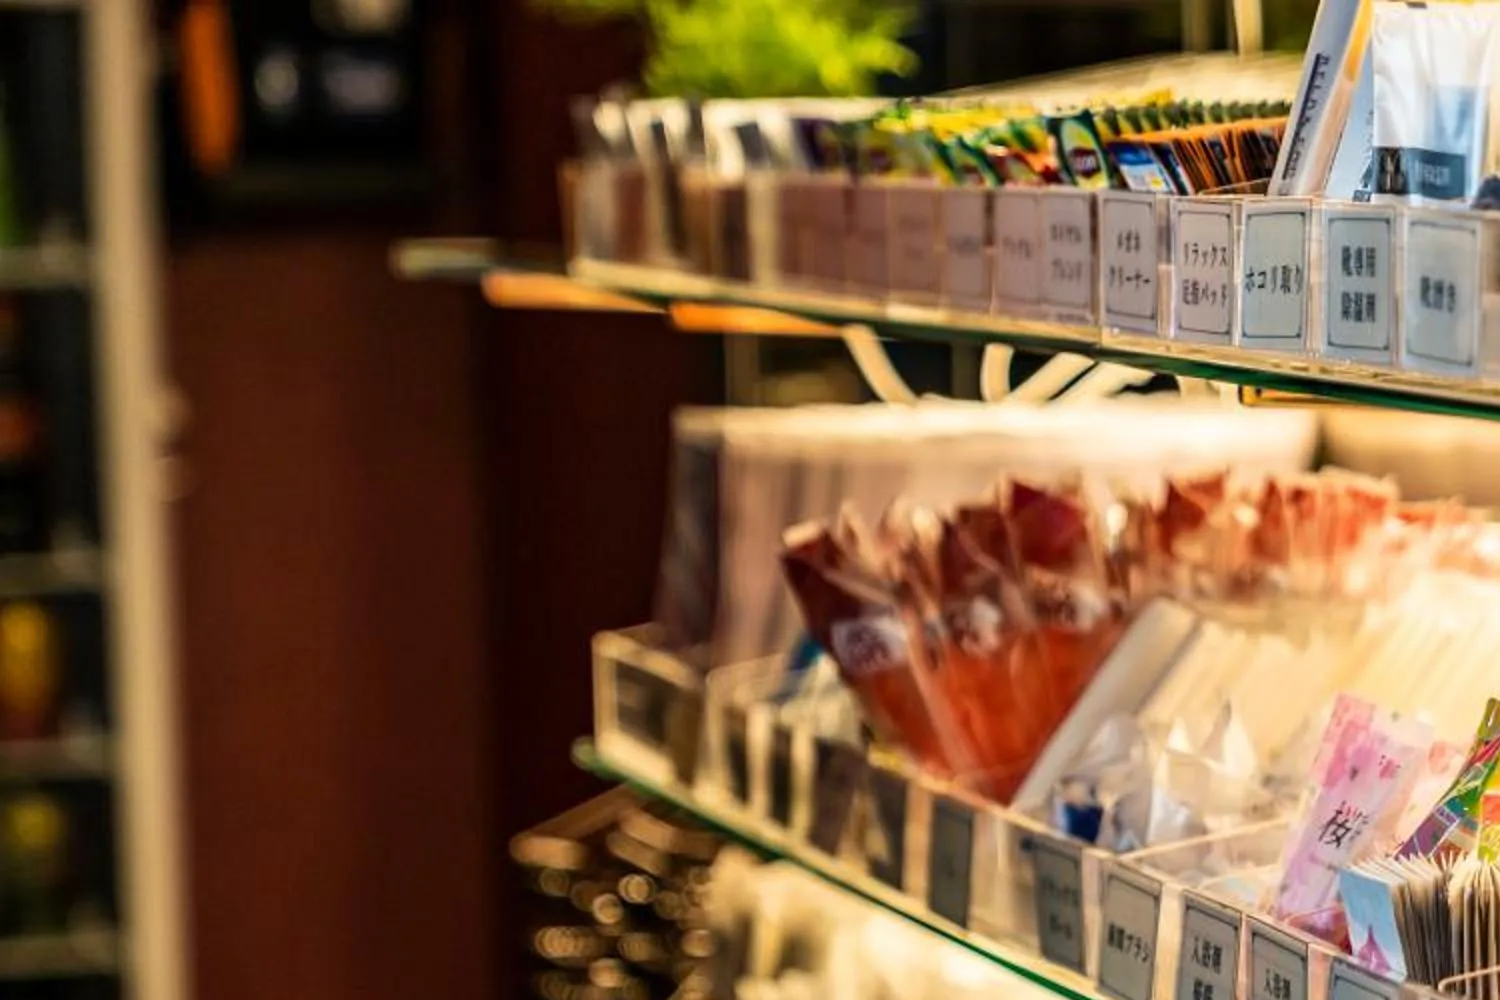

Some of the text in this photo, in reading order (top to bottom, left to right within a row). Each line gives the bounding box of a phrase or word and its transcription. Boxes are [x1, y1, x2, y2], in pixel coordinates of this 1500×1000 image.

[1245, 264, 1303, 295] ホコリ取り
